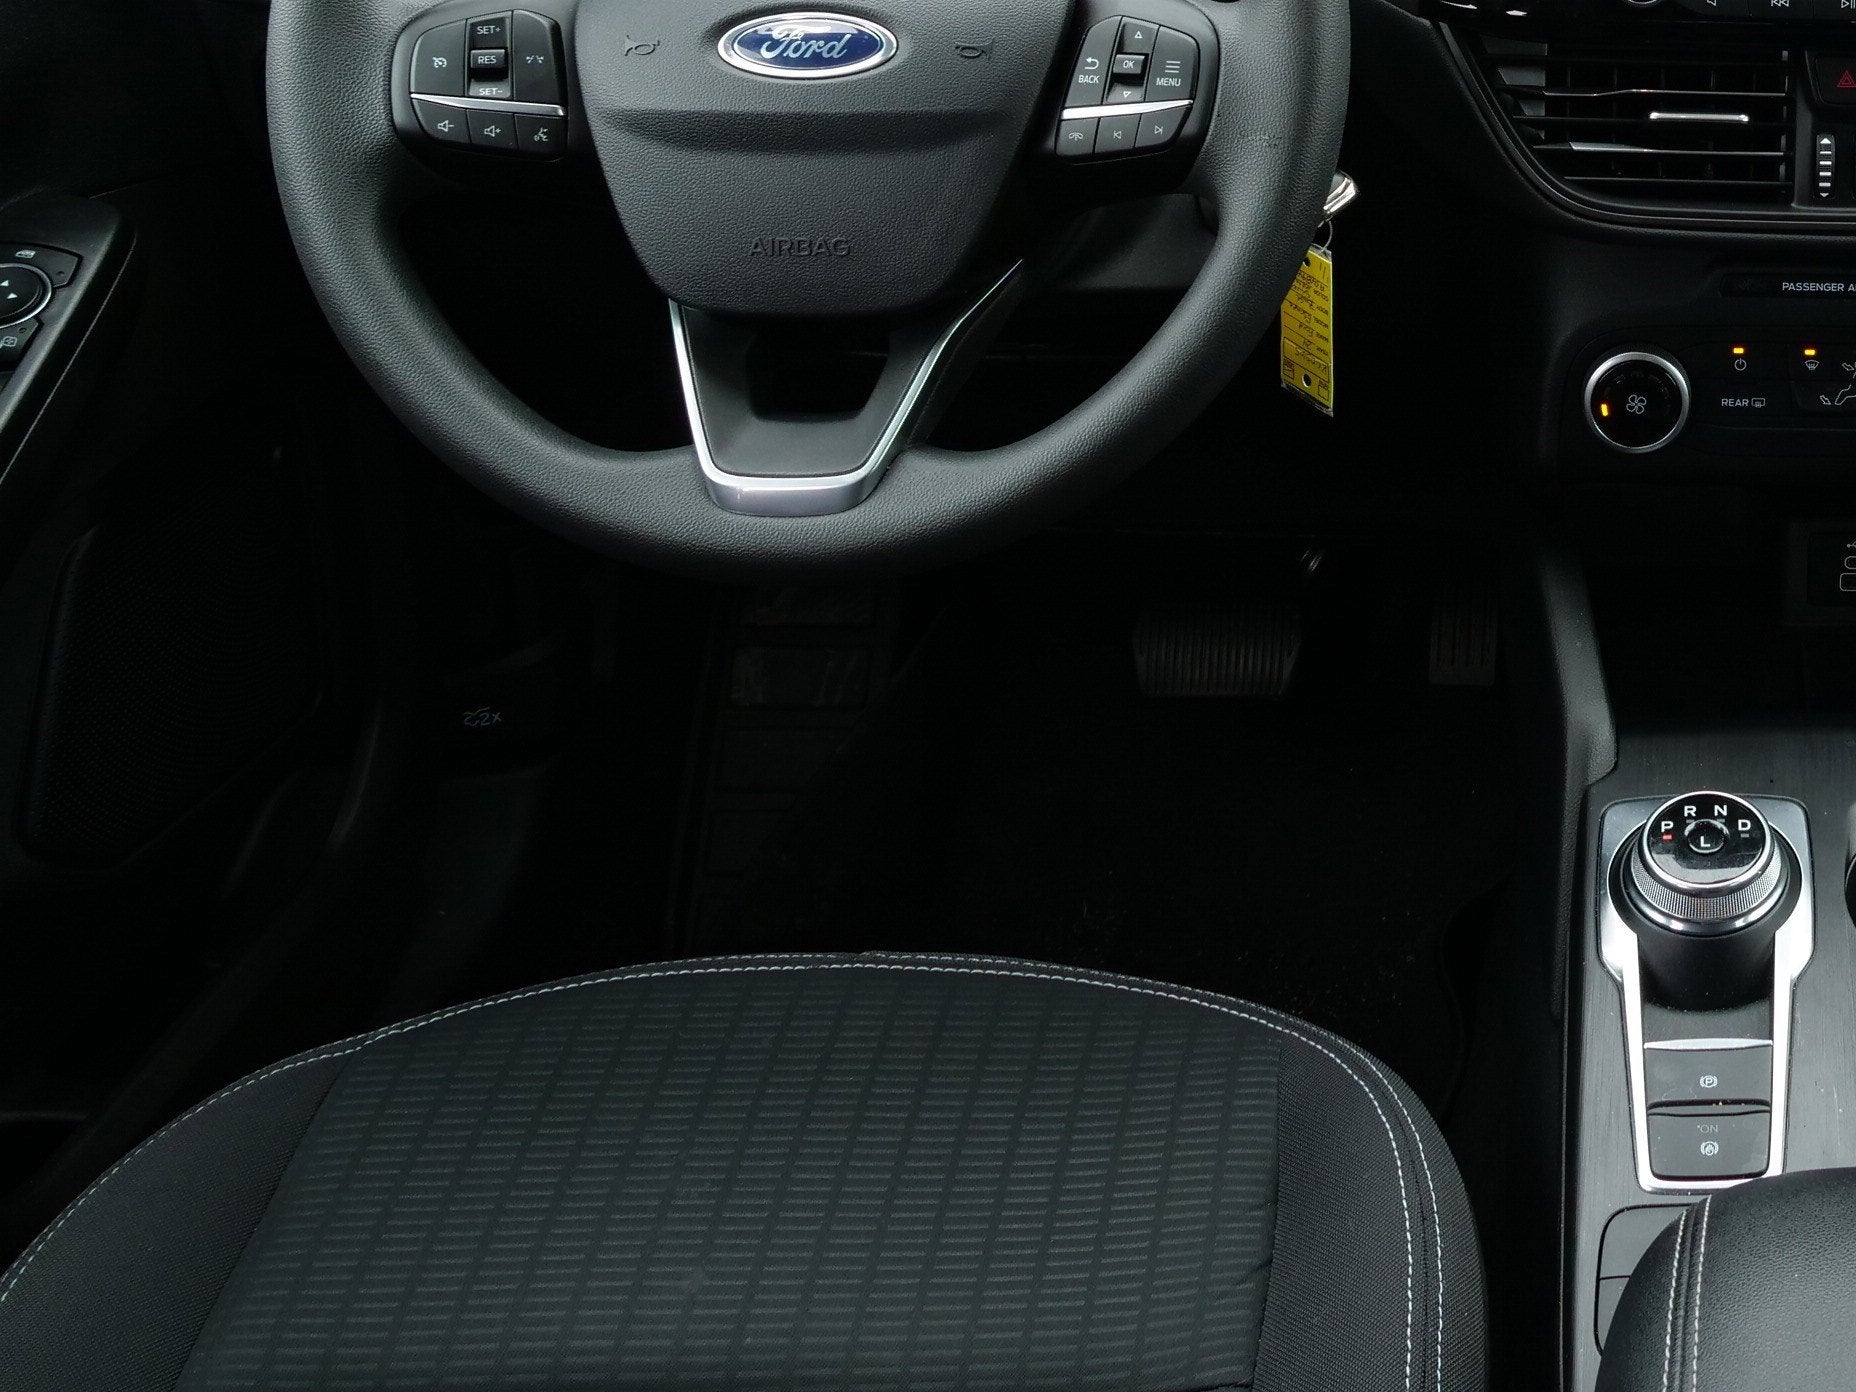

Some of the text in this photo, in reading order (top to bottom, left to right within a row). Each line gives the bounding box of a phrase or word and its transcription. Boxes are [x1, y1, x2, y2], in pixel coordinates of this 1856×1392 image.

[477, 25, 501, 35] SET+
[757, 24, 852, 59] Ford
[477, 55, 497, 64] RES
[1122, 60, 1135, 69] OK
[1078, 75, 1100, 84] BACK
[1156, 78, 1182, 87] MENU
[750, 237, 849, 257] AIRBAG
[1782, 282, 1845, 292] PASSENGER
[1721, 398, 1749, 407] REAR
[1684, 805, 1697, 817] R
[1714, 804, 1728, 816] N
[1661, 821, 1674, 833] P
[1738, 819, 1752, 831] D
[1700, 836, 1711, 847] L
[1700, 1124, 1719, 1134] ON
